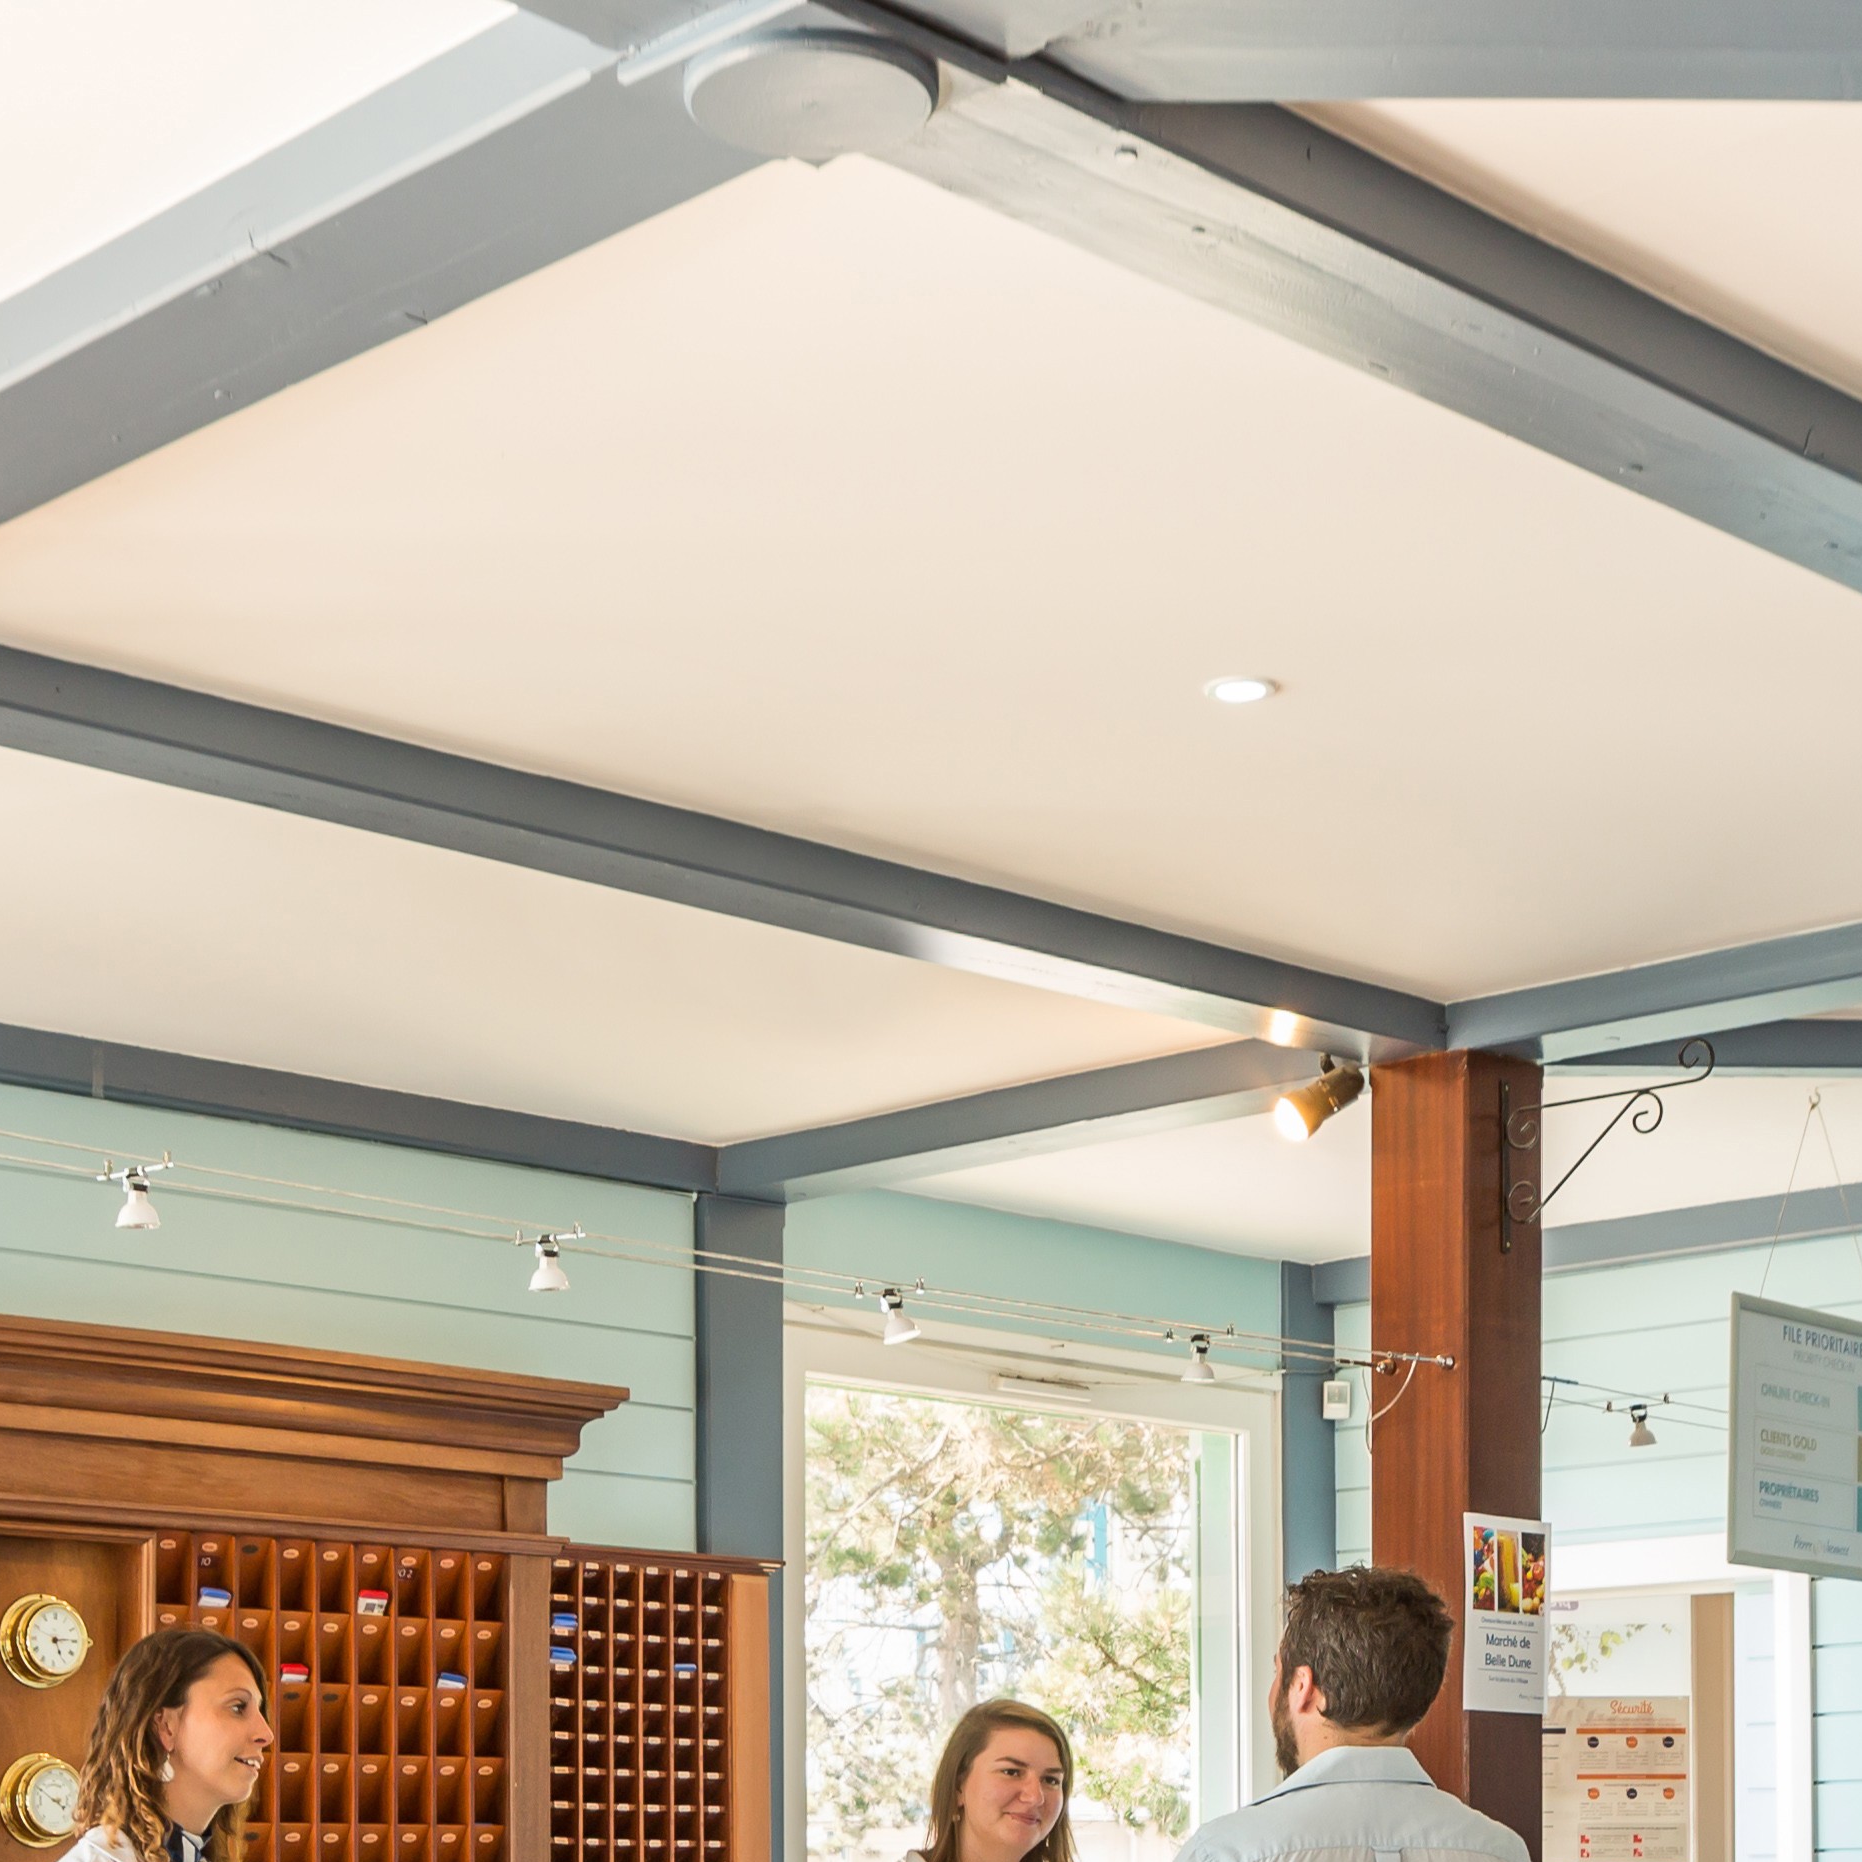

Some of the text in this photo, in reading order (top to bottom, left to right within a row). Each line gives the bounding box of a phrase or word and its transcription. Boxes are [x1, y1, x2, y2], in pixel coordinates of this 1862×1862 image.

[1782, 1325, 1802, 1345] FILE
[1760, 1428, 1817, 1451] CLIENTS GOLD
[1485, 1633, 1531, 1649] Marché de
[1484, 1652, 1532, 1669] Belle Dune
[1610, 1700, 1654, 1715] Sécurité
